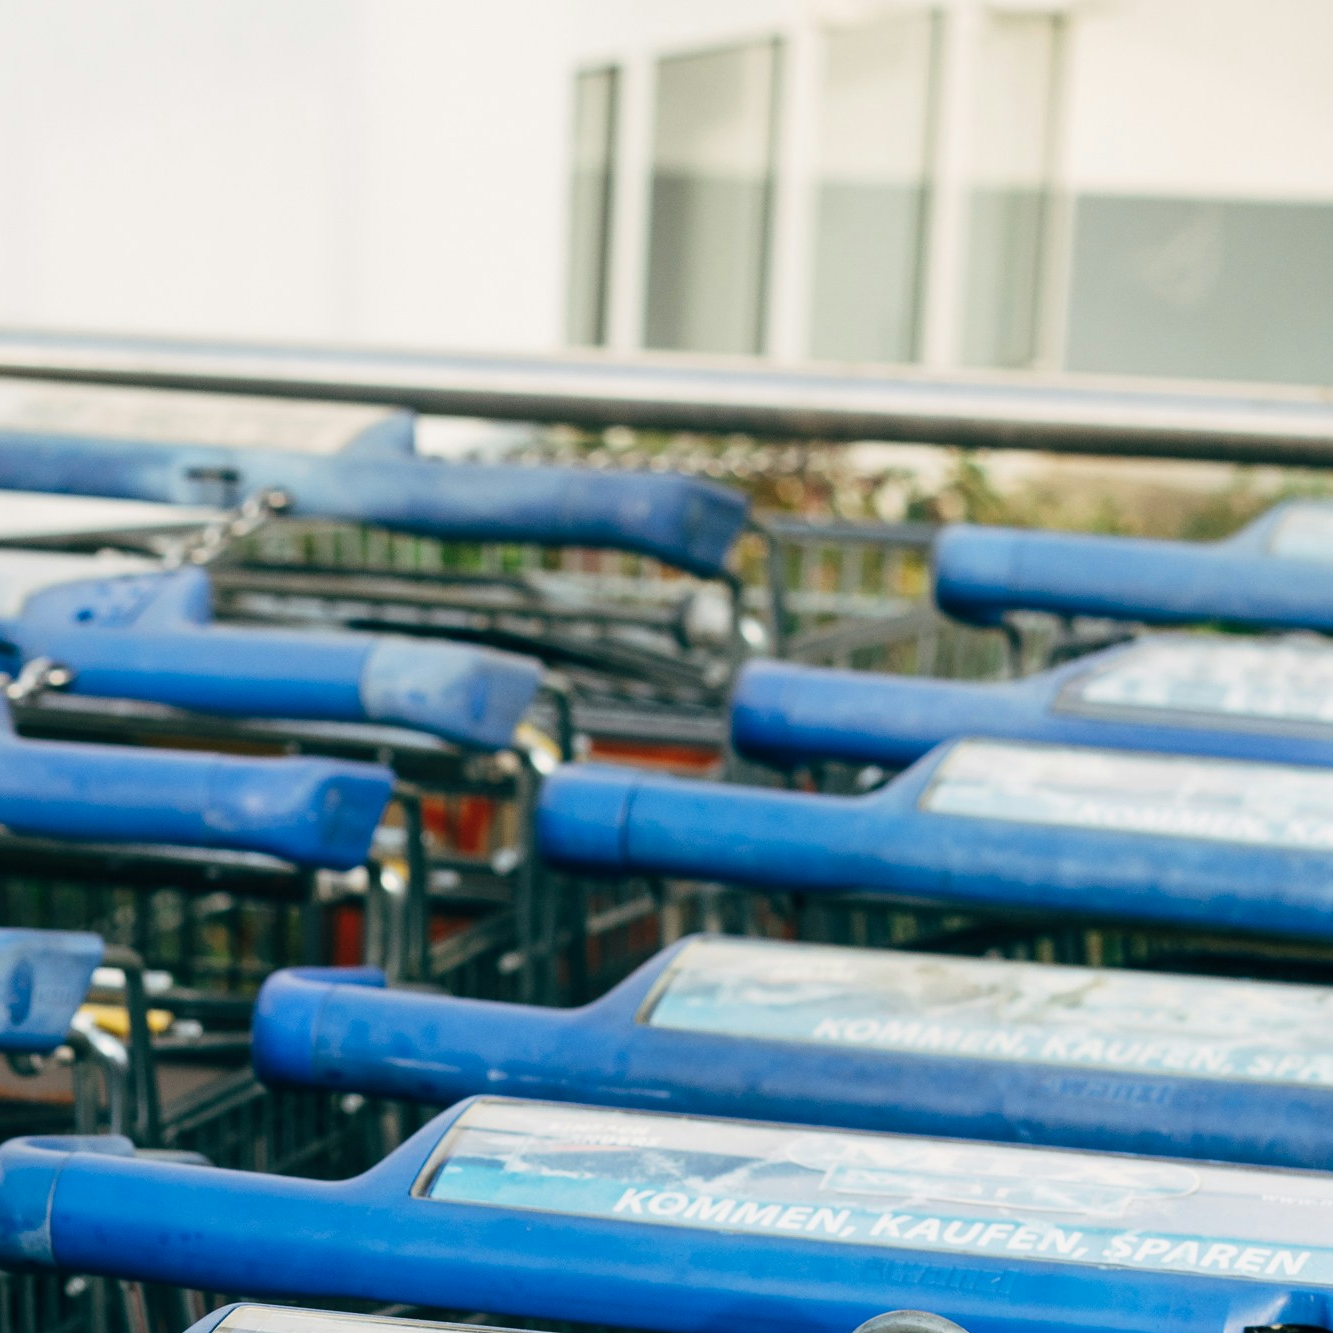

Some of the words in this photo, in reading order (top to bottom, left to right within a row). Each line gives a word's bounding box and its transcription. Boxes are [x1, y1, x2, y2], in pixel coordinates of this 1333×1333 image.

[612, 1187, 857, 1238] KOMMEN,
[869, 1212, 1089, 1260] KAUFEN,
[1102, 1234, 1311, 1276] SPAREN
